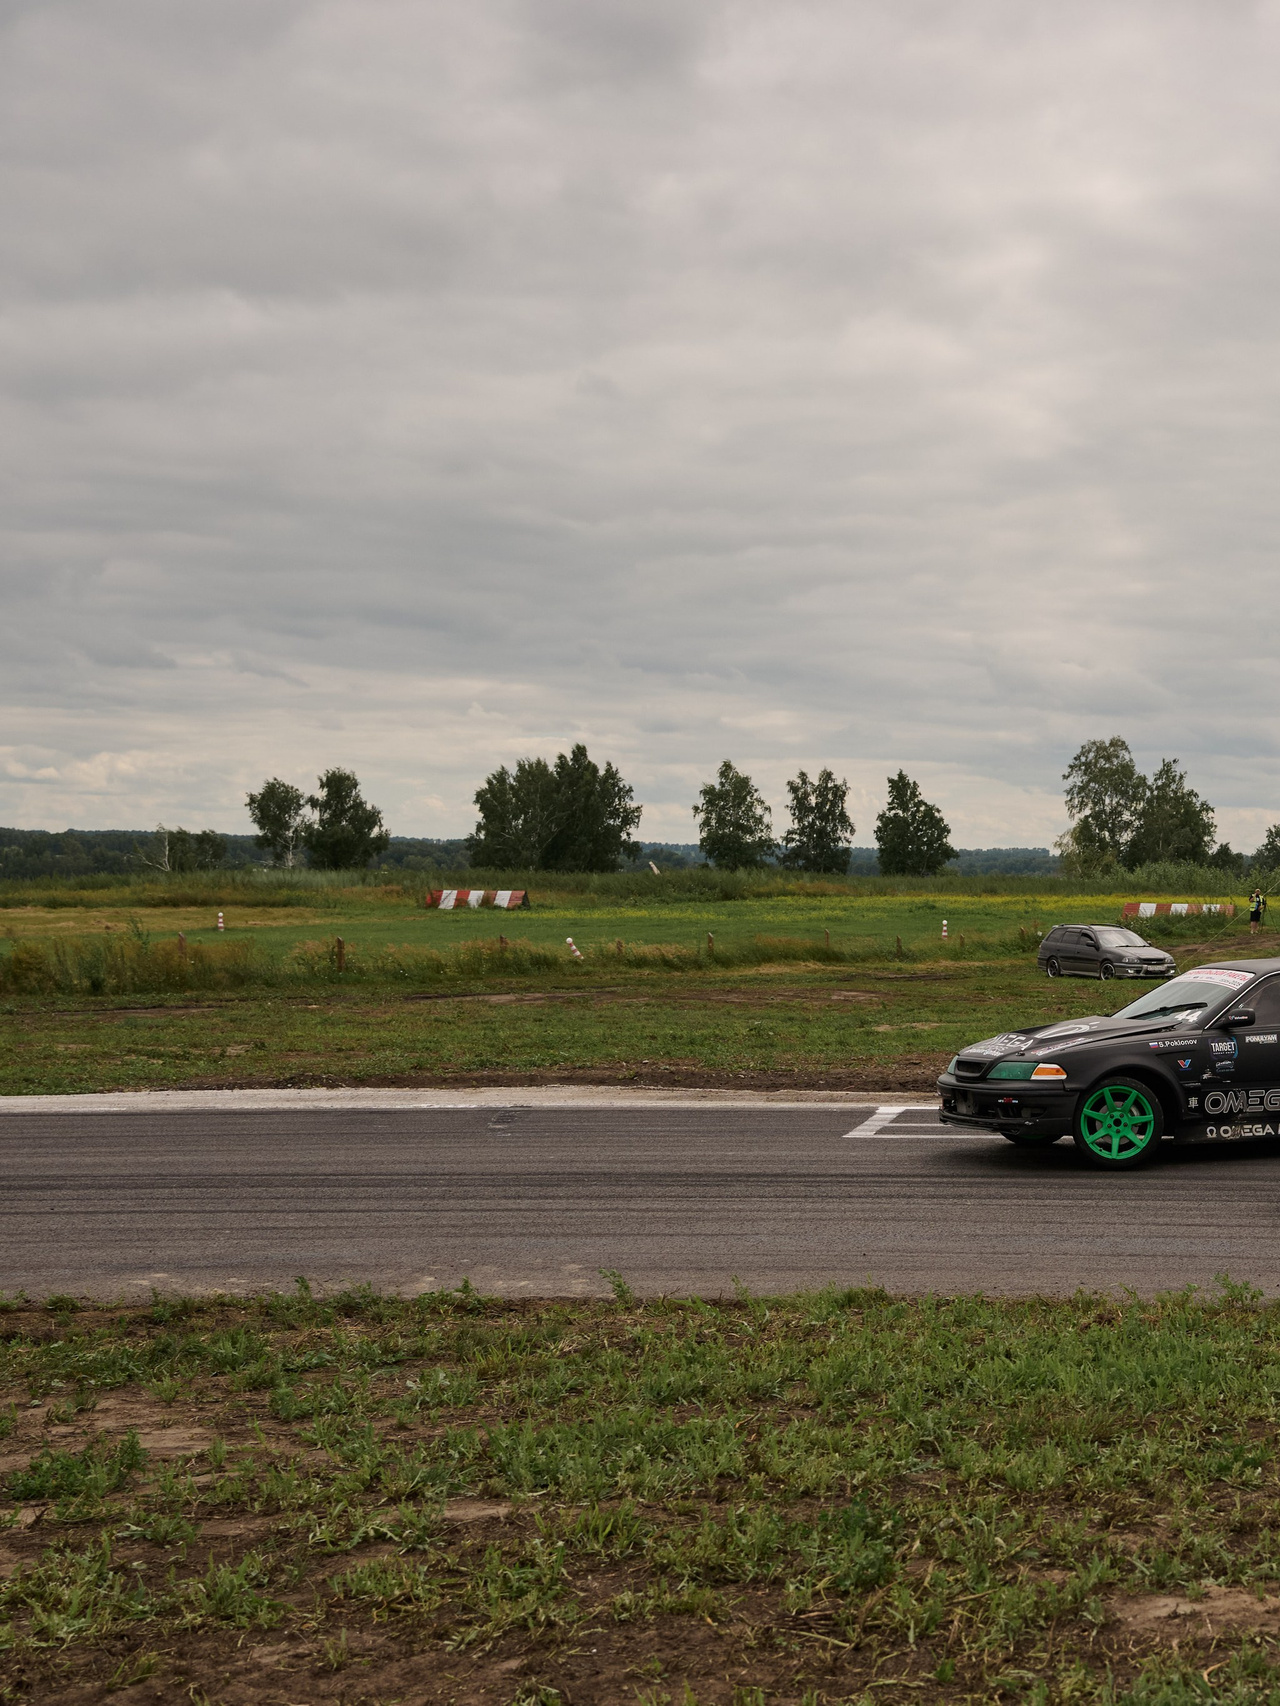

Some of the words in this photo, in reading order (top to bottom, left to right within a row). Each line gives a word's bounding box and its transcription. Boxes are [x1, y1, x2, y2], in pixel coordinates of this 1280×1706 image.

[1174, 1009, 1203, 1022] 44
[1158, 1039, 1198, 1048] S.Poklonov
[1210, 1041, 1236, 1053] TARGET
